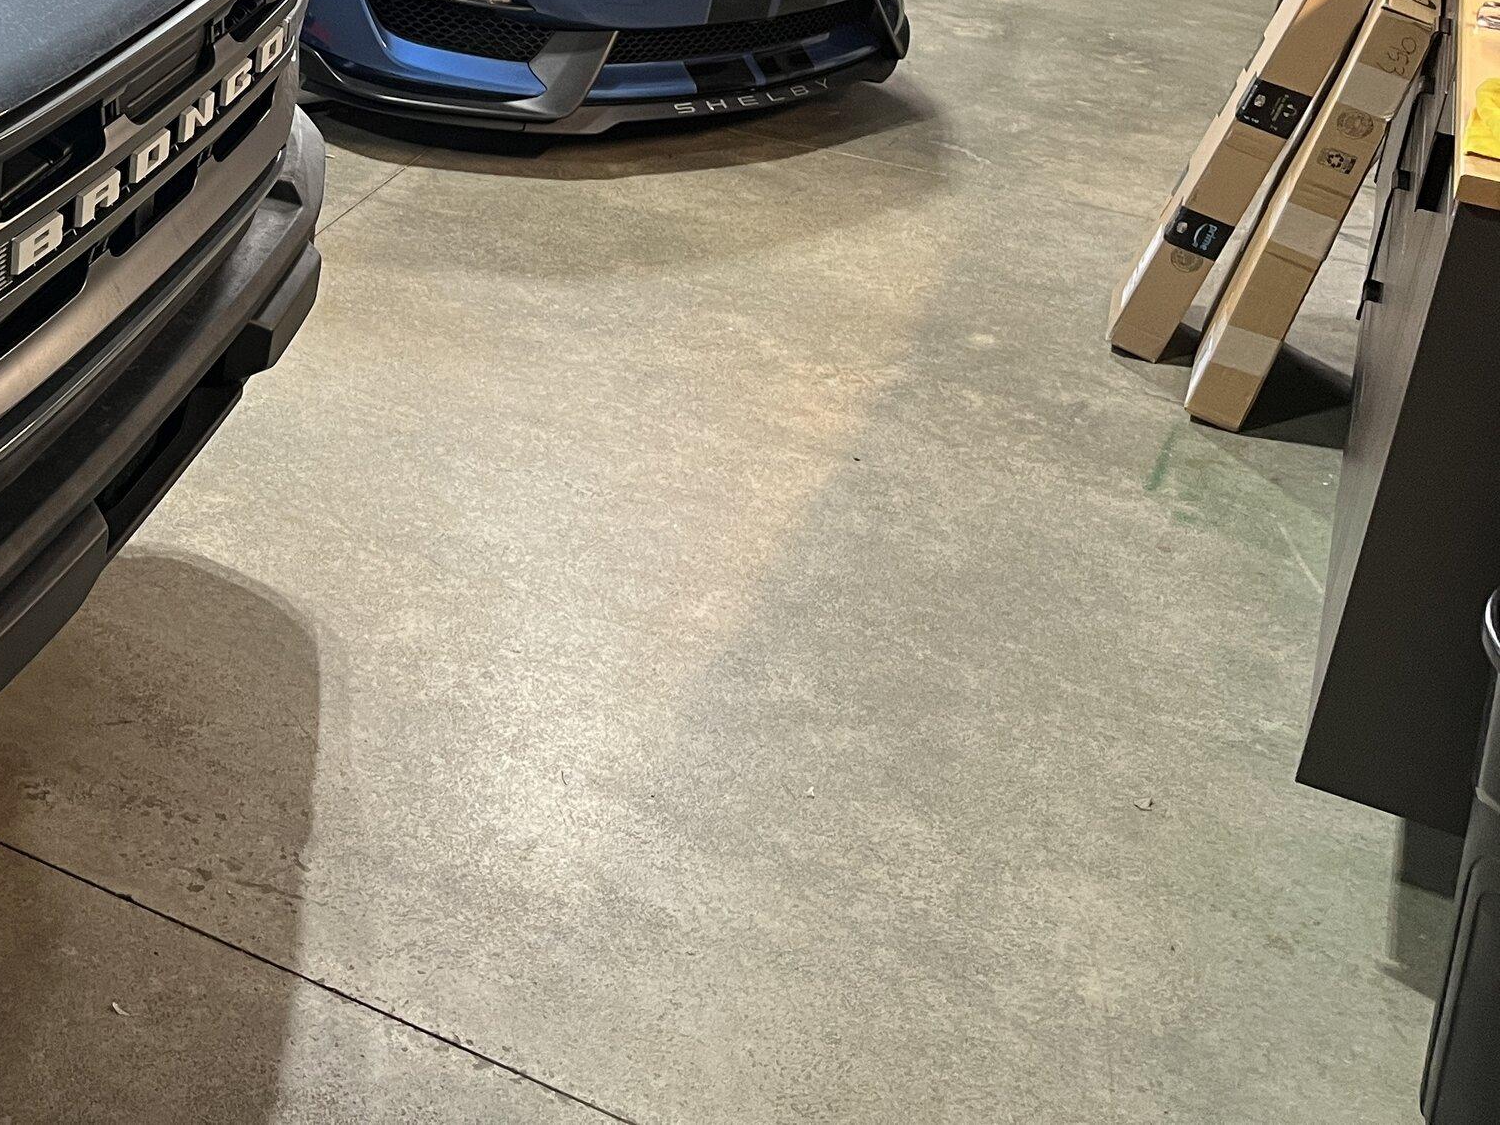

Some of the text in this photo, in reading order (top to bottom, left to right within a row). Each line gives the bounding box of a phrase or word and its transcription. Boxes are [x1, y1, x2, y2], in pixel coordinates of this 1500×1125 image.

[674, 77, 829, 114] SHELBY
[10, 25, 285, 276] BRONCO
[1200, 223, 1218, 251] prime
